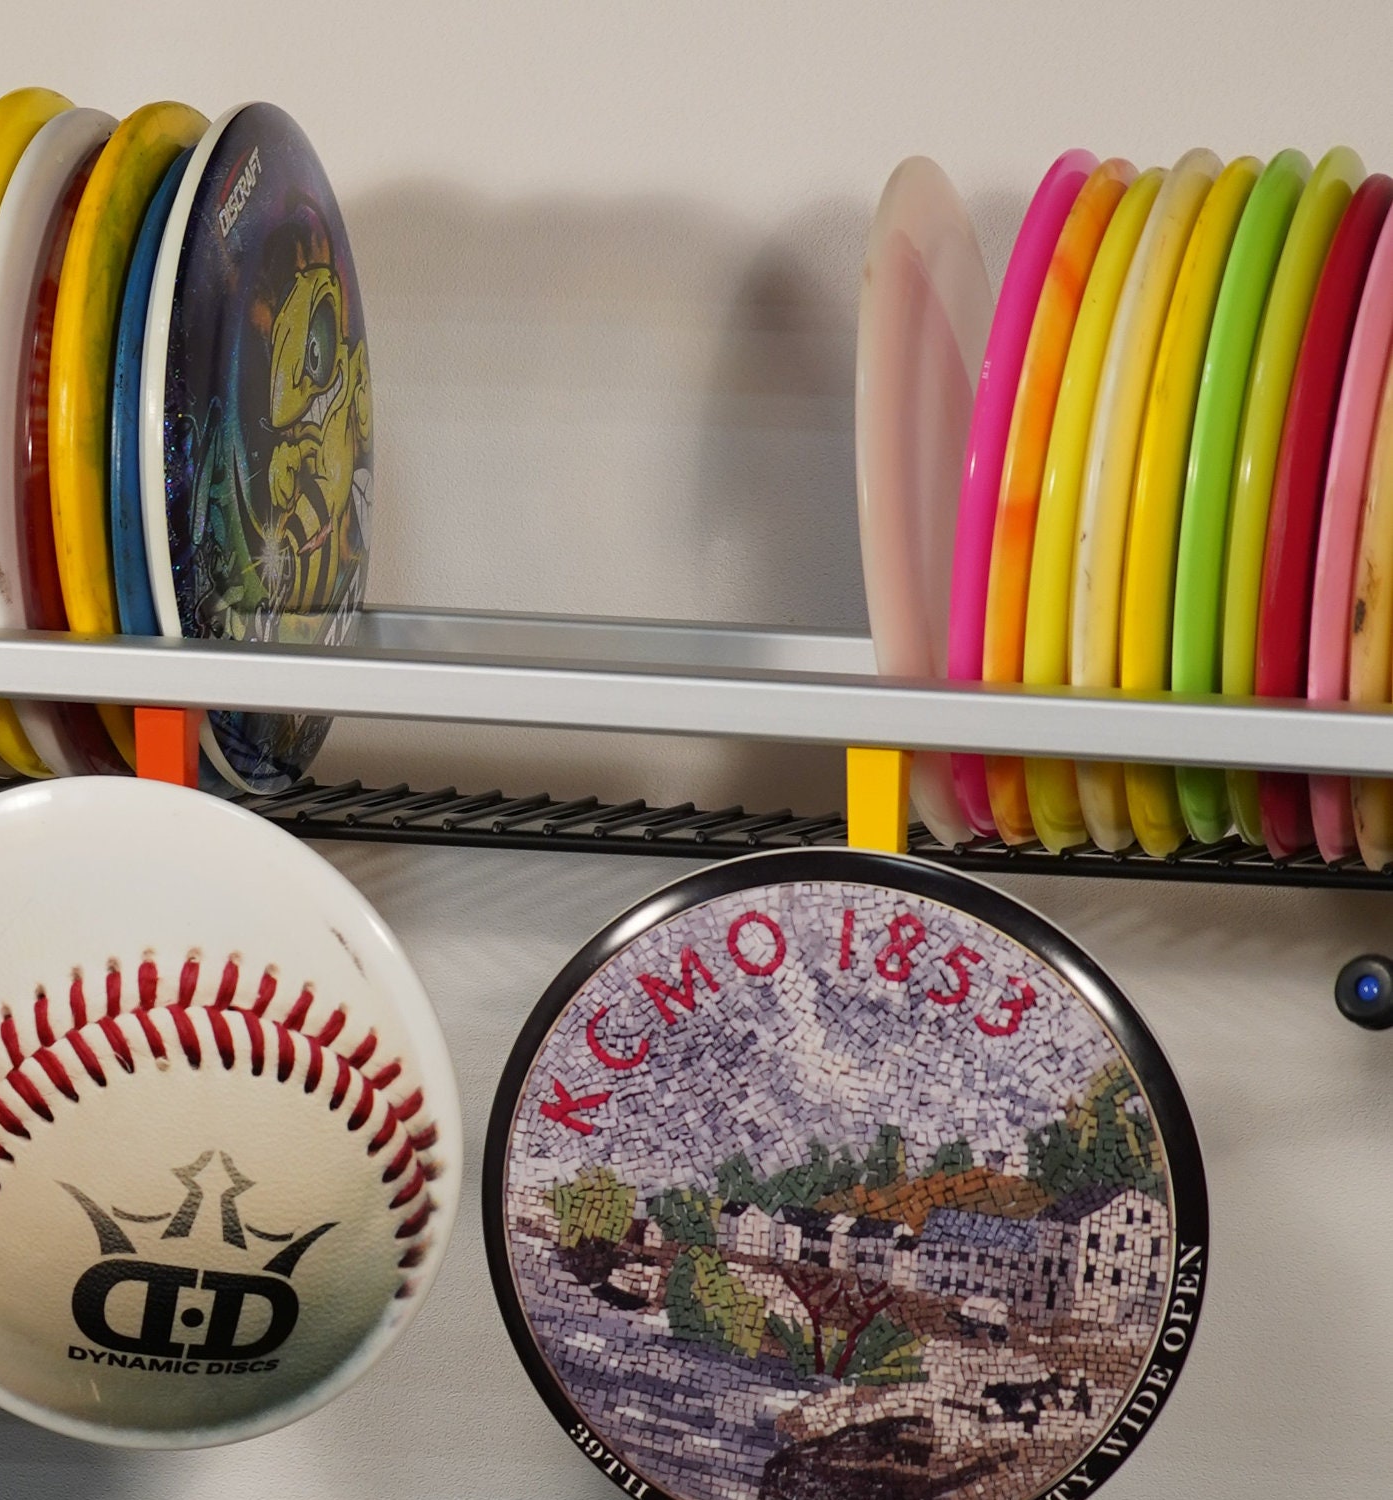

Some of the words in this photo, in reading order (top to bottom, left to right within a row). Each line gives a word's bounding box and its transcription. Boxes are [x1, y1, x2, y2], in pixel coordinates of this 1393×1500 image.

[218, 145, 262, 238] DISCRAFT
[839, 909, 1037, 1037] 1853
[67, 1346, 200, 1375] DYNAMIC
[205, 1358, 281, 1376] DISCS
[569, 1423, 650, 1500] 39TH
[1098, 1364, 1174, 1457] WIDE
[1162, 1242, 1203, 1353] OPEN
